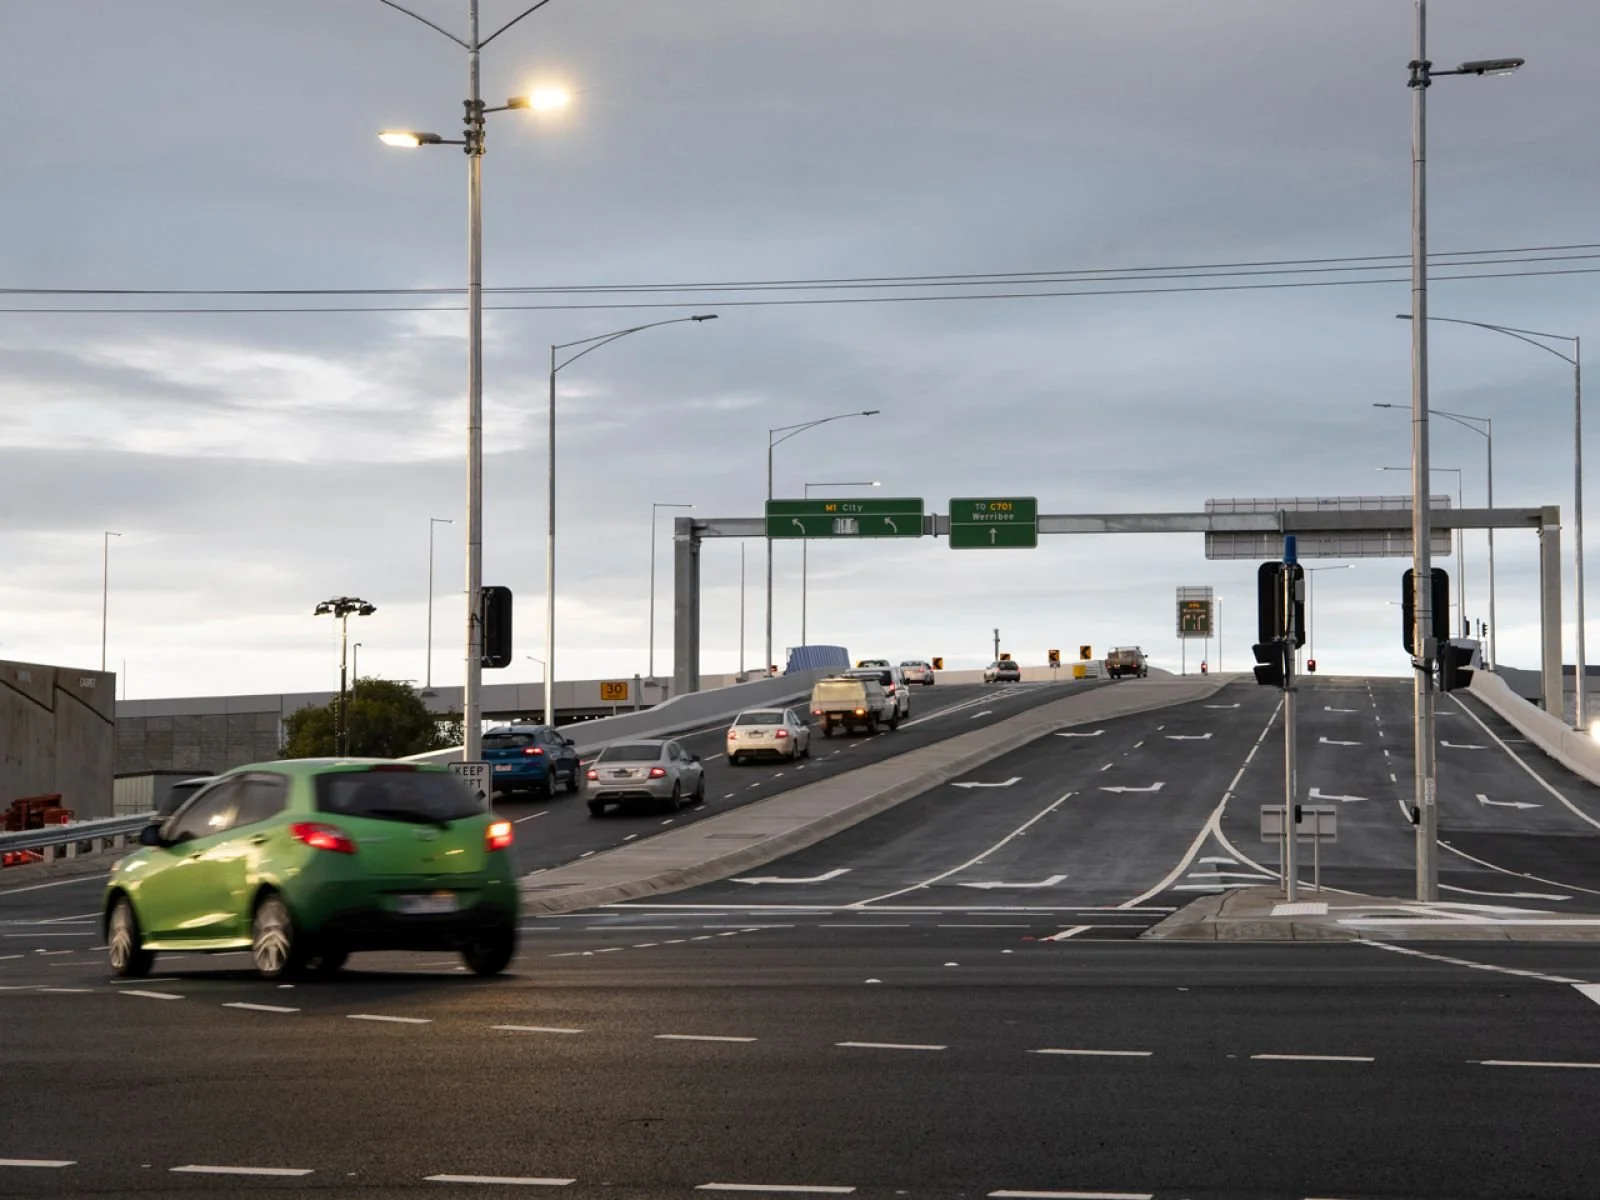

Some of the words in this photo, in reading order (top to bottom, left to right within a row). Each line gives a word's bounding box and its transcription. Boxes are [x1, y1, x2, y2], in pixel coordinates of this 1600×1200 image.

[842, 504, 863, 512] City
[975, 503, 986, 511] TO
[990, 503, 1012, 511] C701
[972, 512, 1015, 520] Werribee
[607, 684, 621, 694] 30
[455, 766, 483, 776] KEEP
